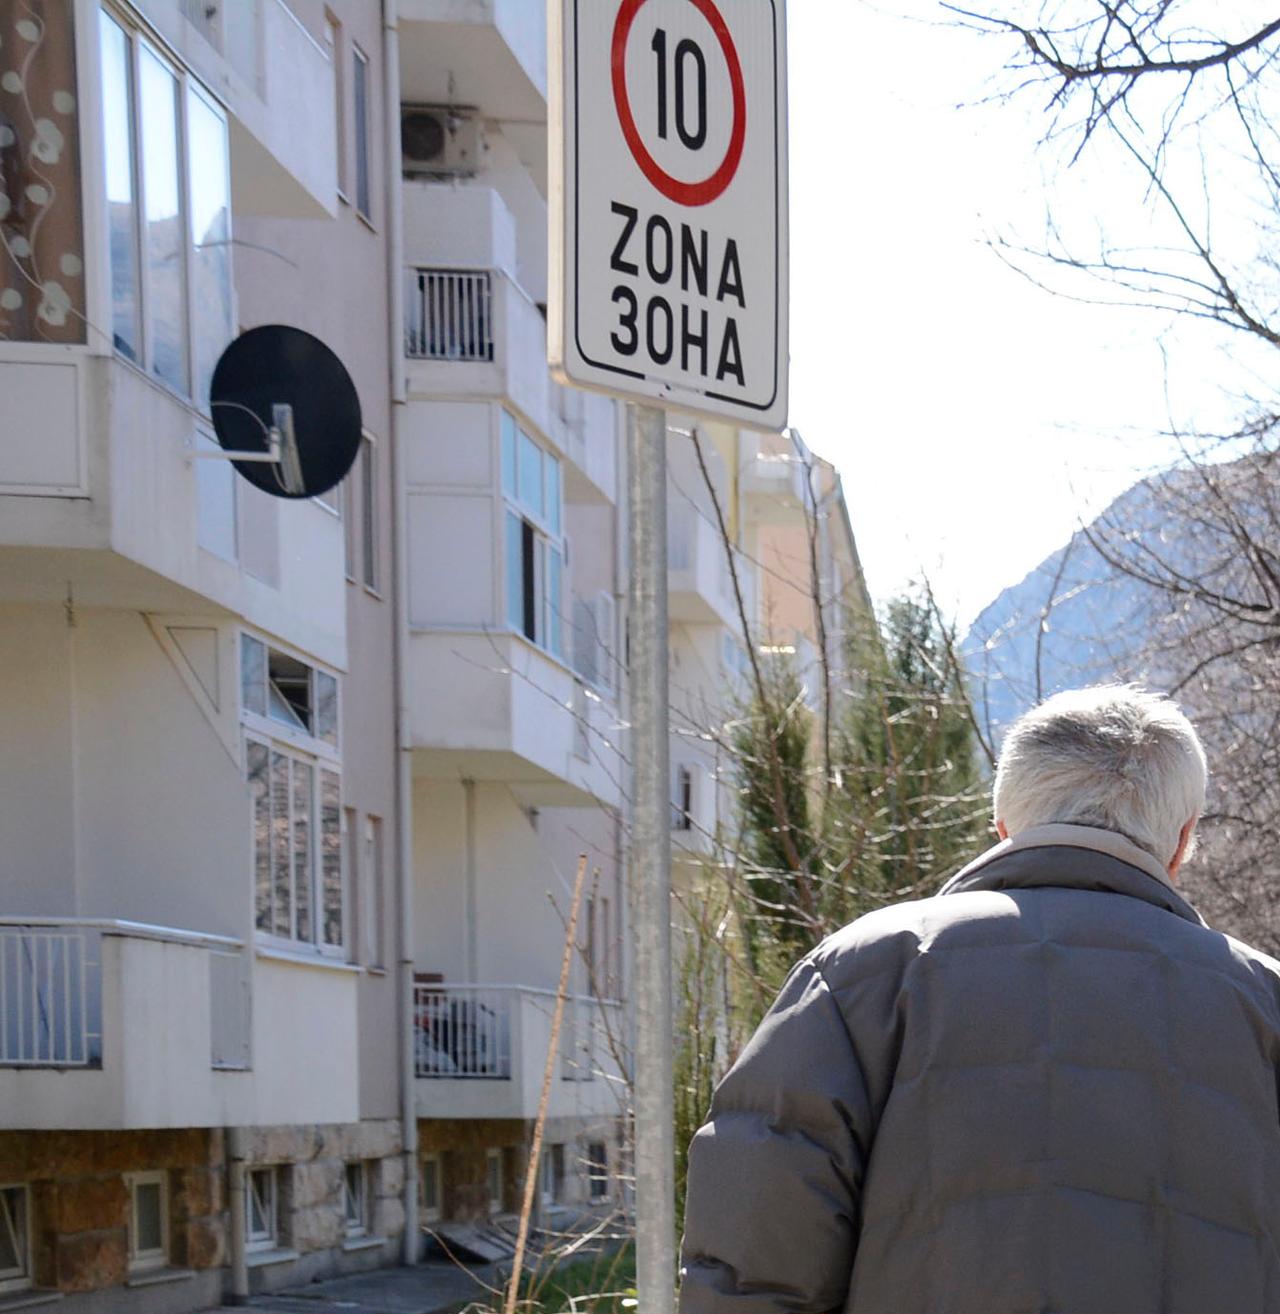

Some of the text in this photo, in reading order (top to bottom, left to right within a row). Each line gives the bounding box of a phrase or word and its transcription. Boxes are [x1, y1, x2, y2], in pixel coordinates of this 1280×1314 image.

[651, 27, 707, 151] 10
[610, 201, 746, 309] ZONA
[610, 285, 746, 387] ЗОНА
